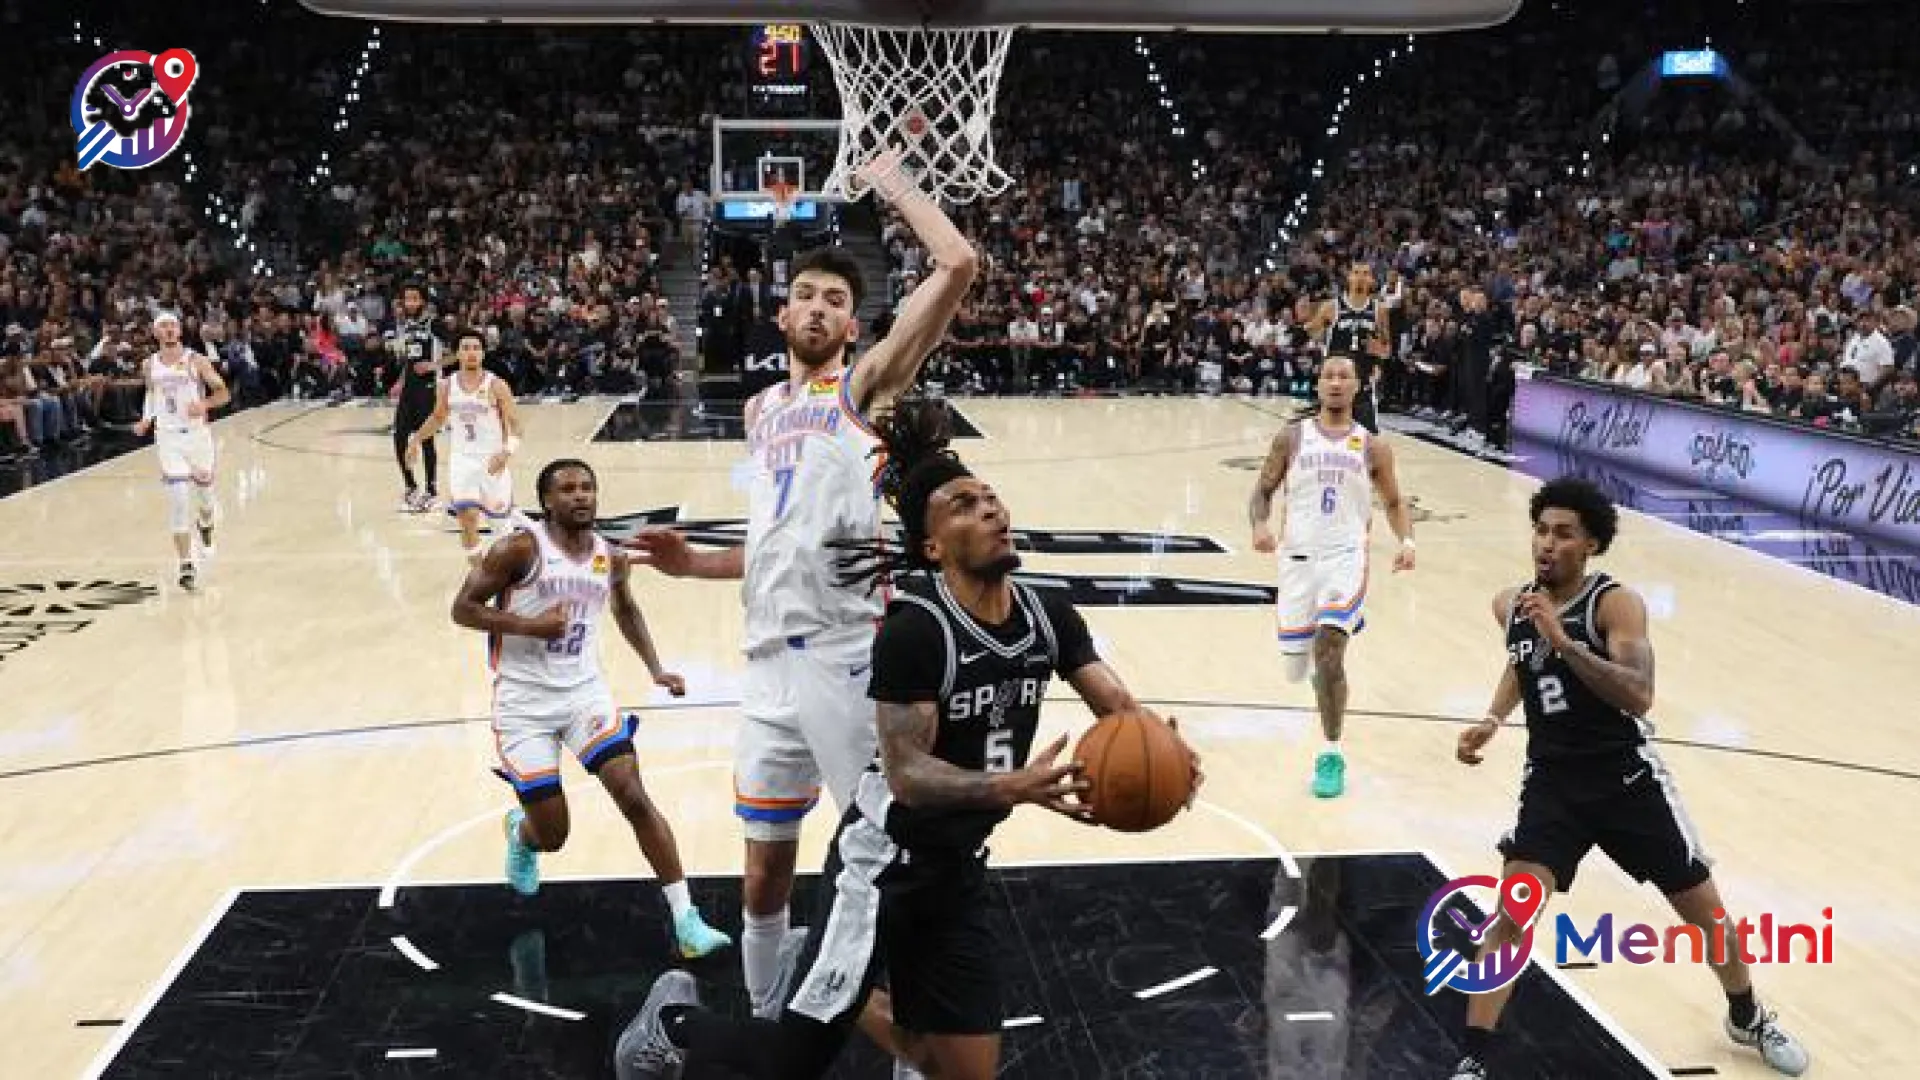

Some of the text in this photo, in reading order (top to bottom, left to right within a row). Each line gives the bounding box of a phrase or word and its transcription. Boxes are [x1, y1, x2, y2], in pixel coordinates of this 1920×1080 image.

[759, 41, 800, 75] 21
[775, 466, 795, 519] 7
[1321, 486, 1336, 515] 6
[1538, 675, 1569, 715] 2
[984, 729, 1014, 773] 5
